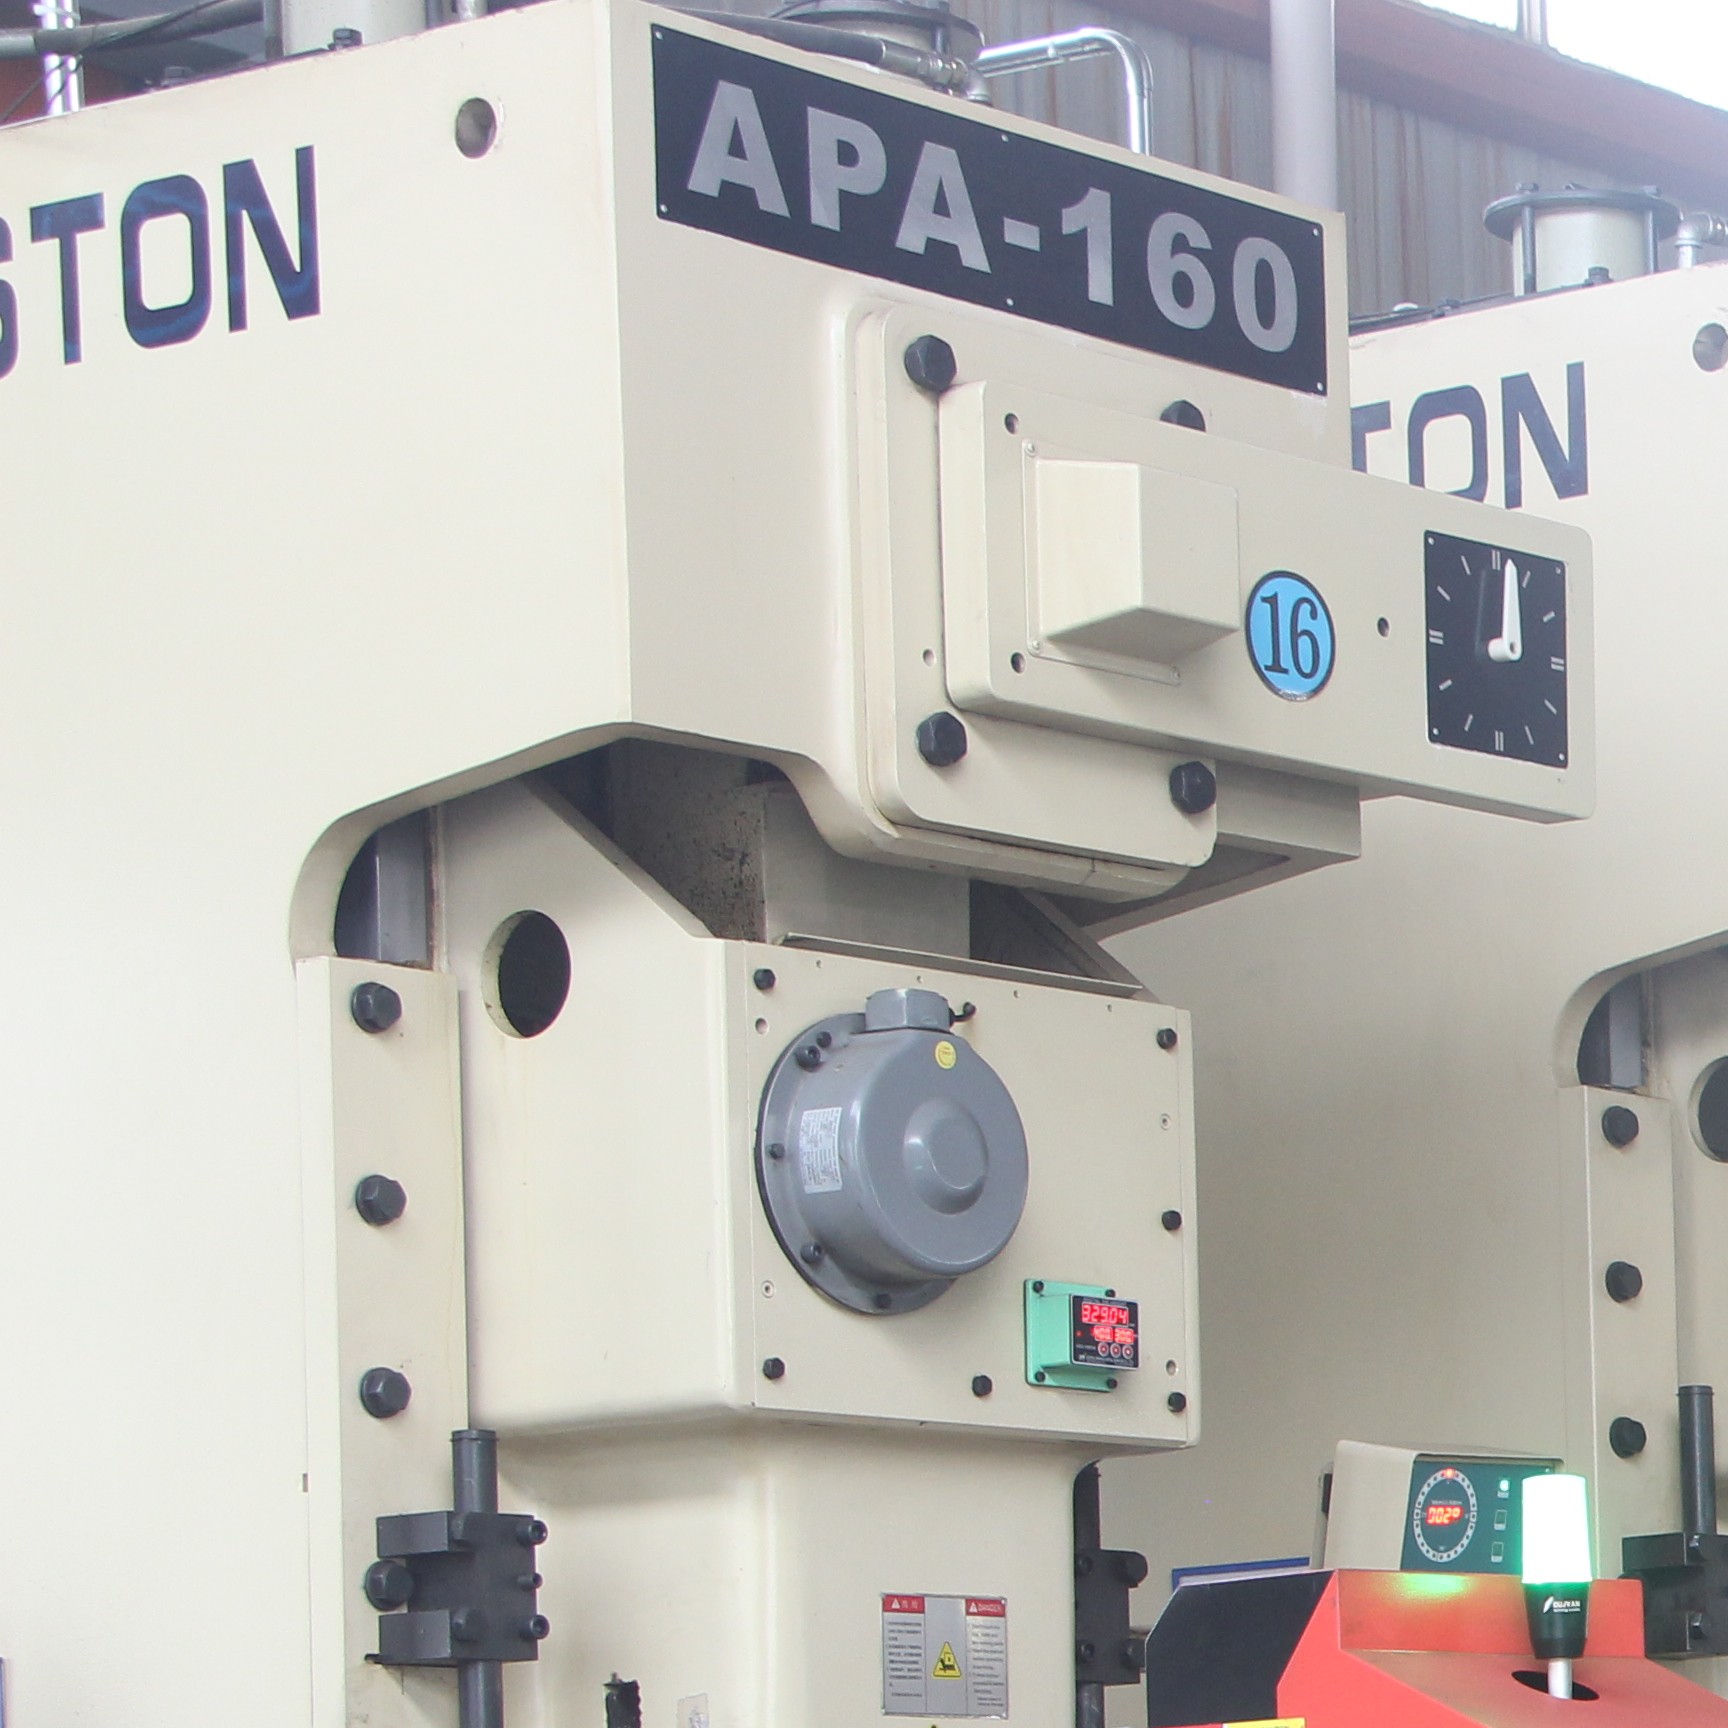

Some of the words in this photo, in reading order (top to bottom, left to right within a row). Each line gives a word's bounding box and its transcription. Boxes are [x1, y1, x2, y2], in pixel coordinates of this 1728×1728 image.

[0, 144, 322, 381] TON
[686, 79, 1299, 354] APA-160
[1256, 592, 1321, 680] 16
